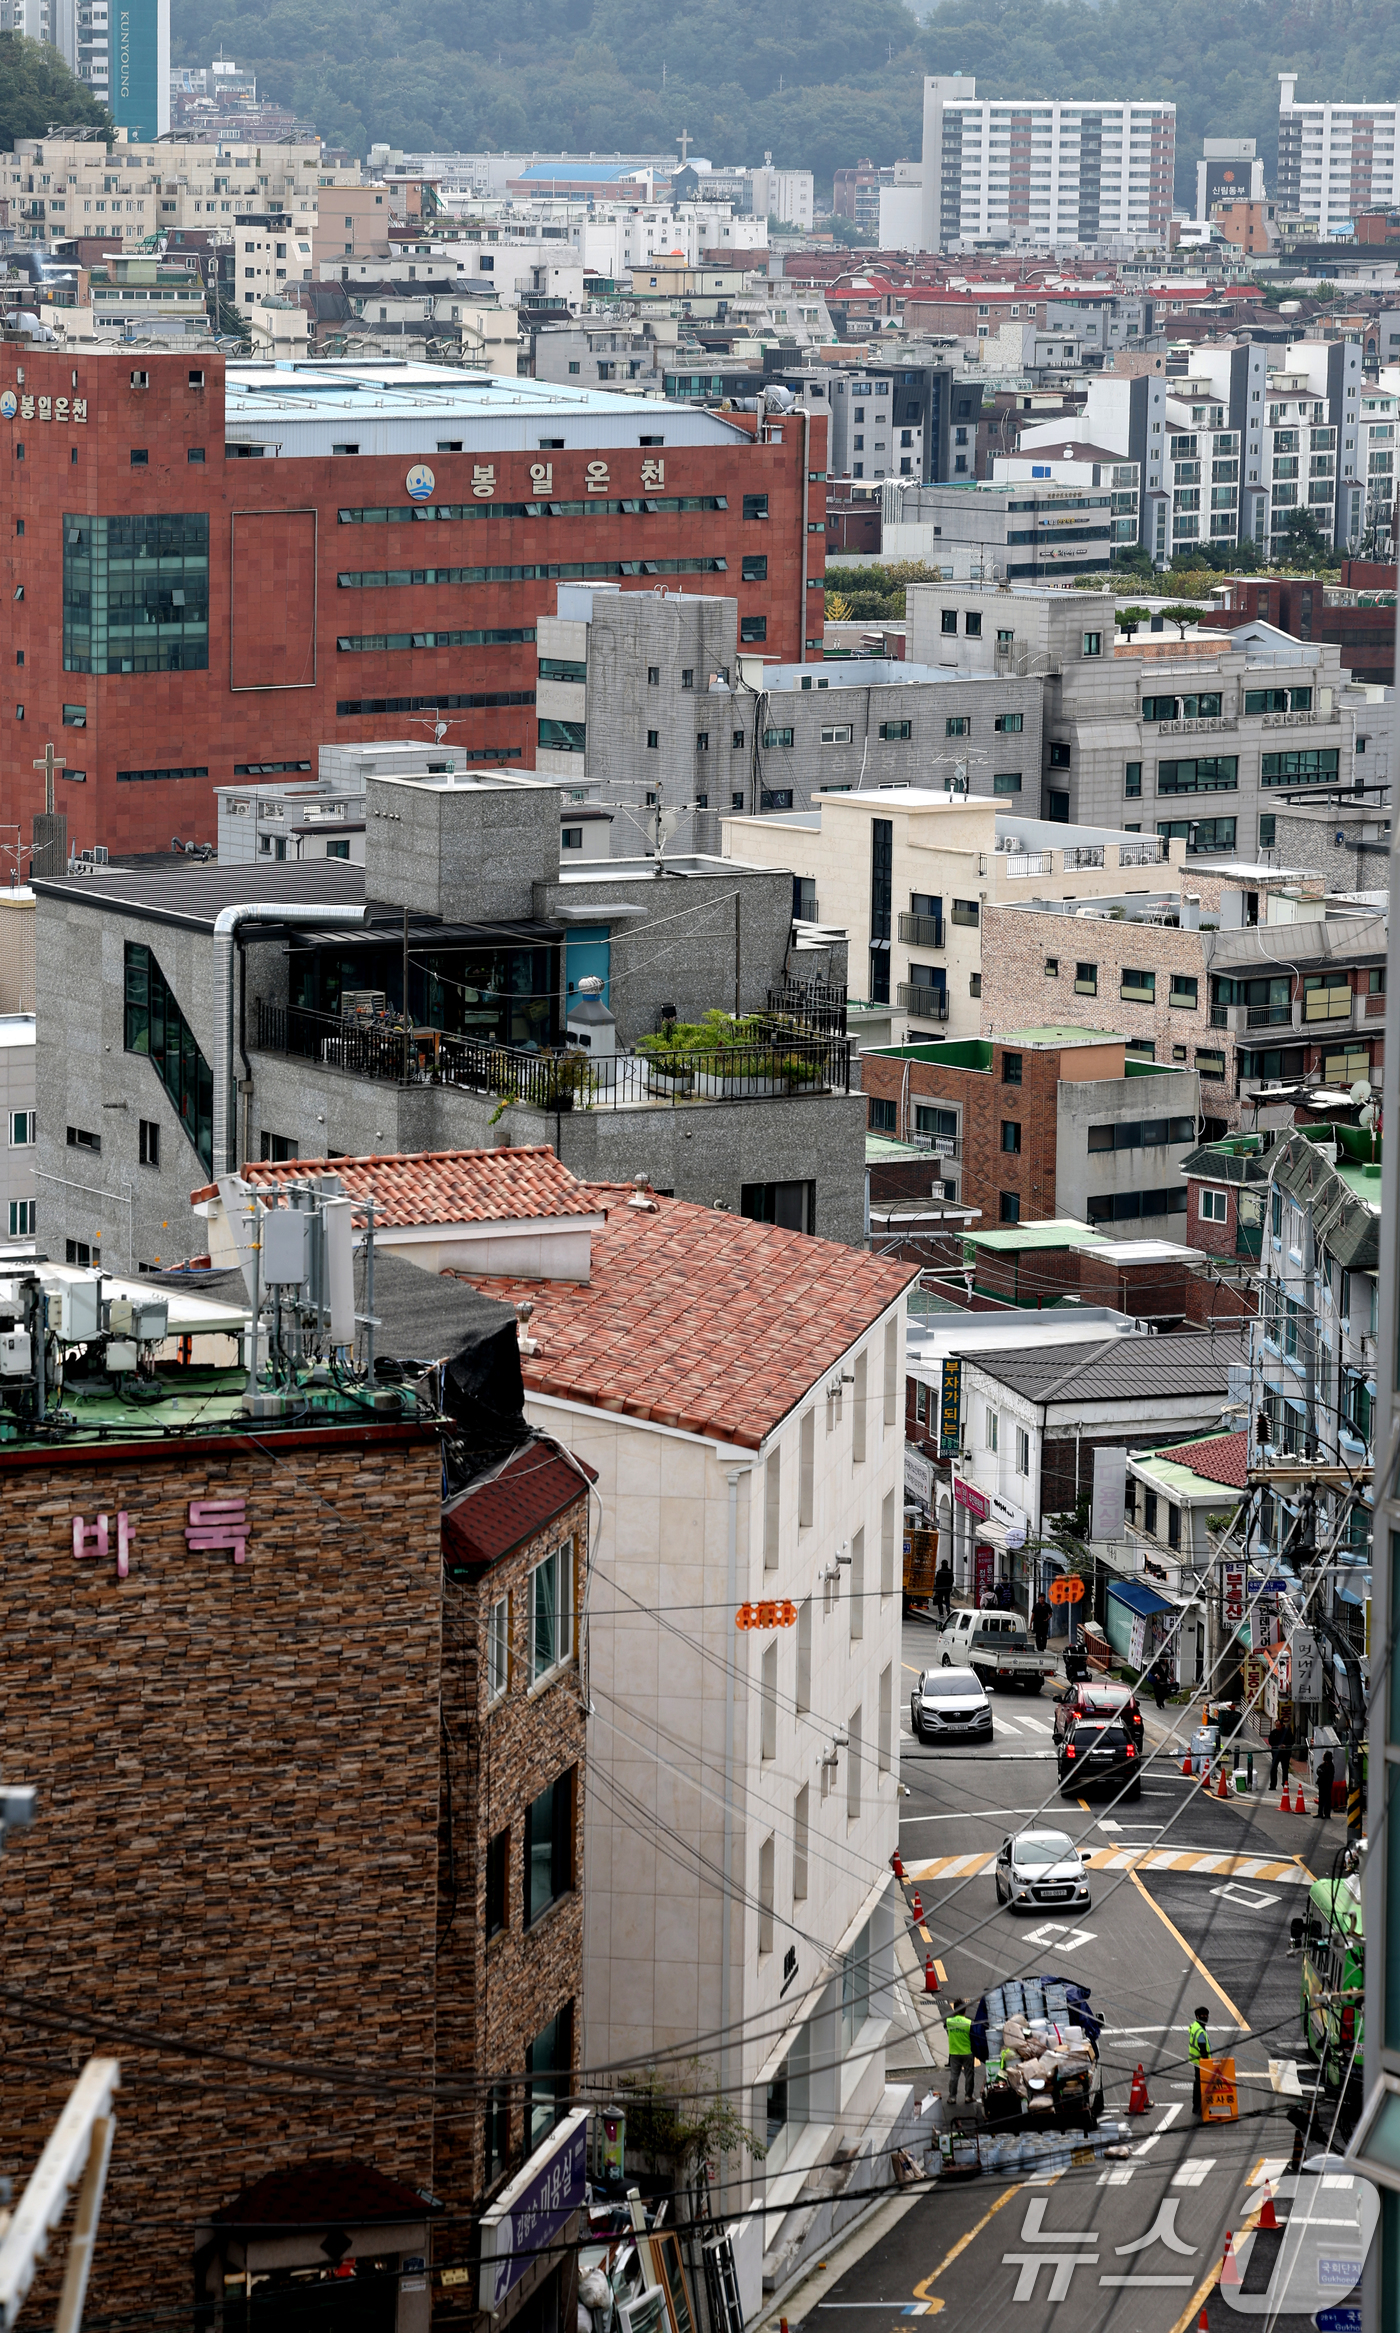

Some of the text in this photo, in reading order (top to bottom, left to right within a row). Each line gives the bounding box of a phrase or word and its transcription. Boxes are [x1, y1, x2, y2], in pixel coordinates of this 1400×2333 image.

[120, 10, 130, 98] KUNYOUNG
[1212, 186, 1245, 195] 신림동부
[20, 394, 87, 423] 봉일온천
[470, 459, 665, 498] 봉일온천
[1098, 1465, 1120, 1528] 미용실
[1225, 1573, 1244, 1621] 부동산
[1206, 2095, 1235, 2105] 공사중
[540, 2148, 574, 2220] 미용실
